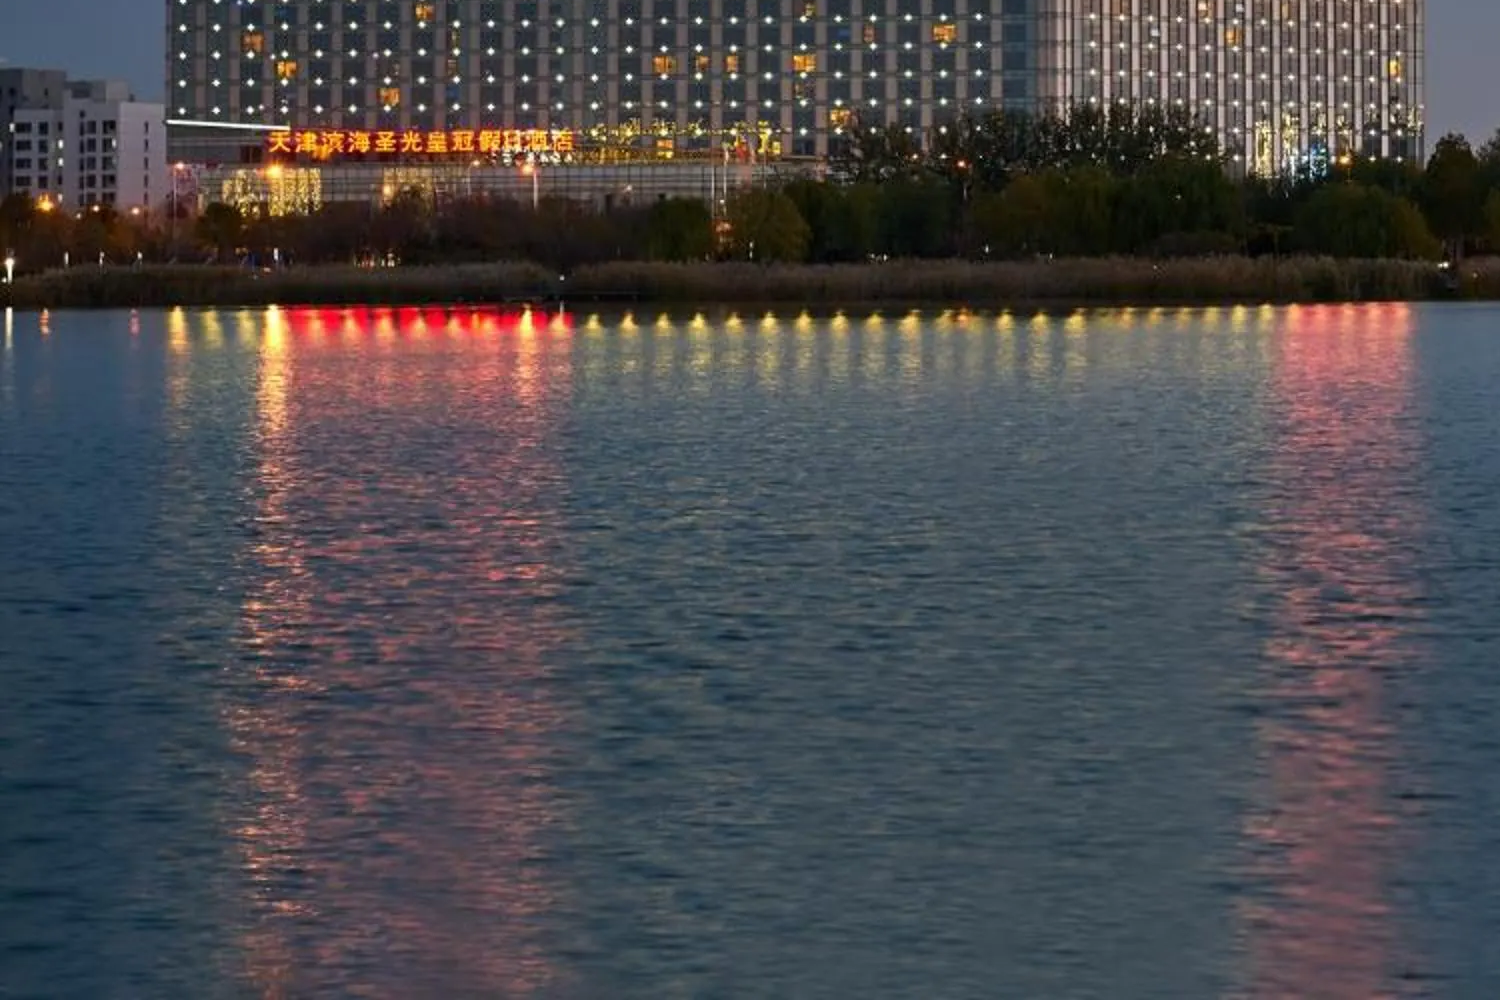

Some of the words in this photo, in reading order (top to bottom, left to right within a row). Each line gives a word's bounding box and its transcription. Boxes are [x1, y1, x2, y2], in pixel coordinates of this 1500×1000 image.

[268, 130, 574, 152] 天津滨海圣光皇冠假日酒店
